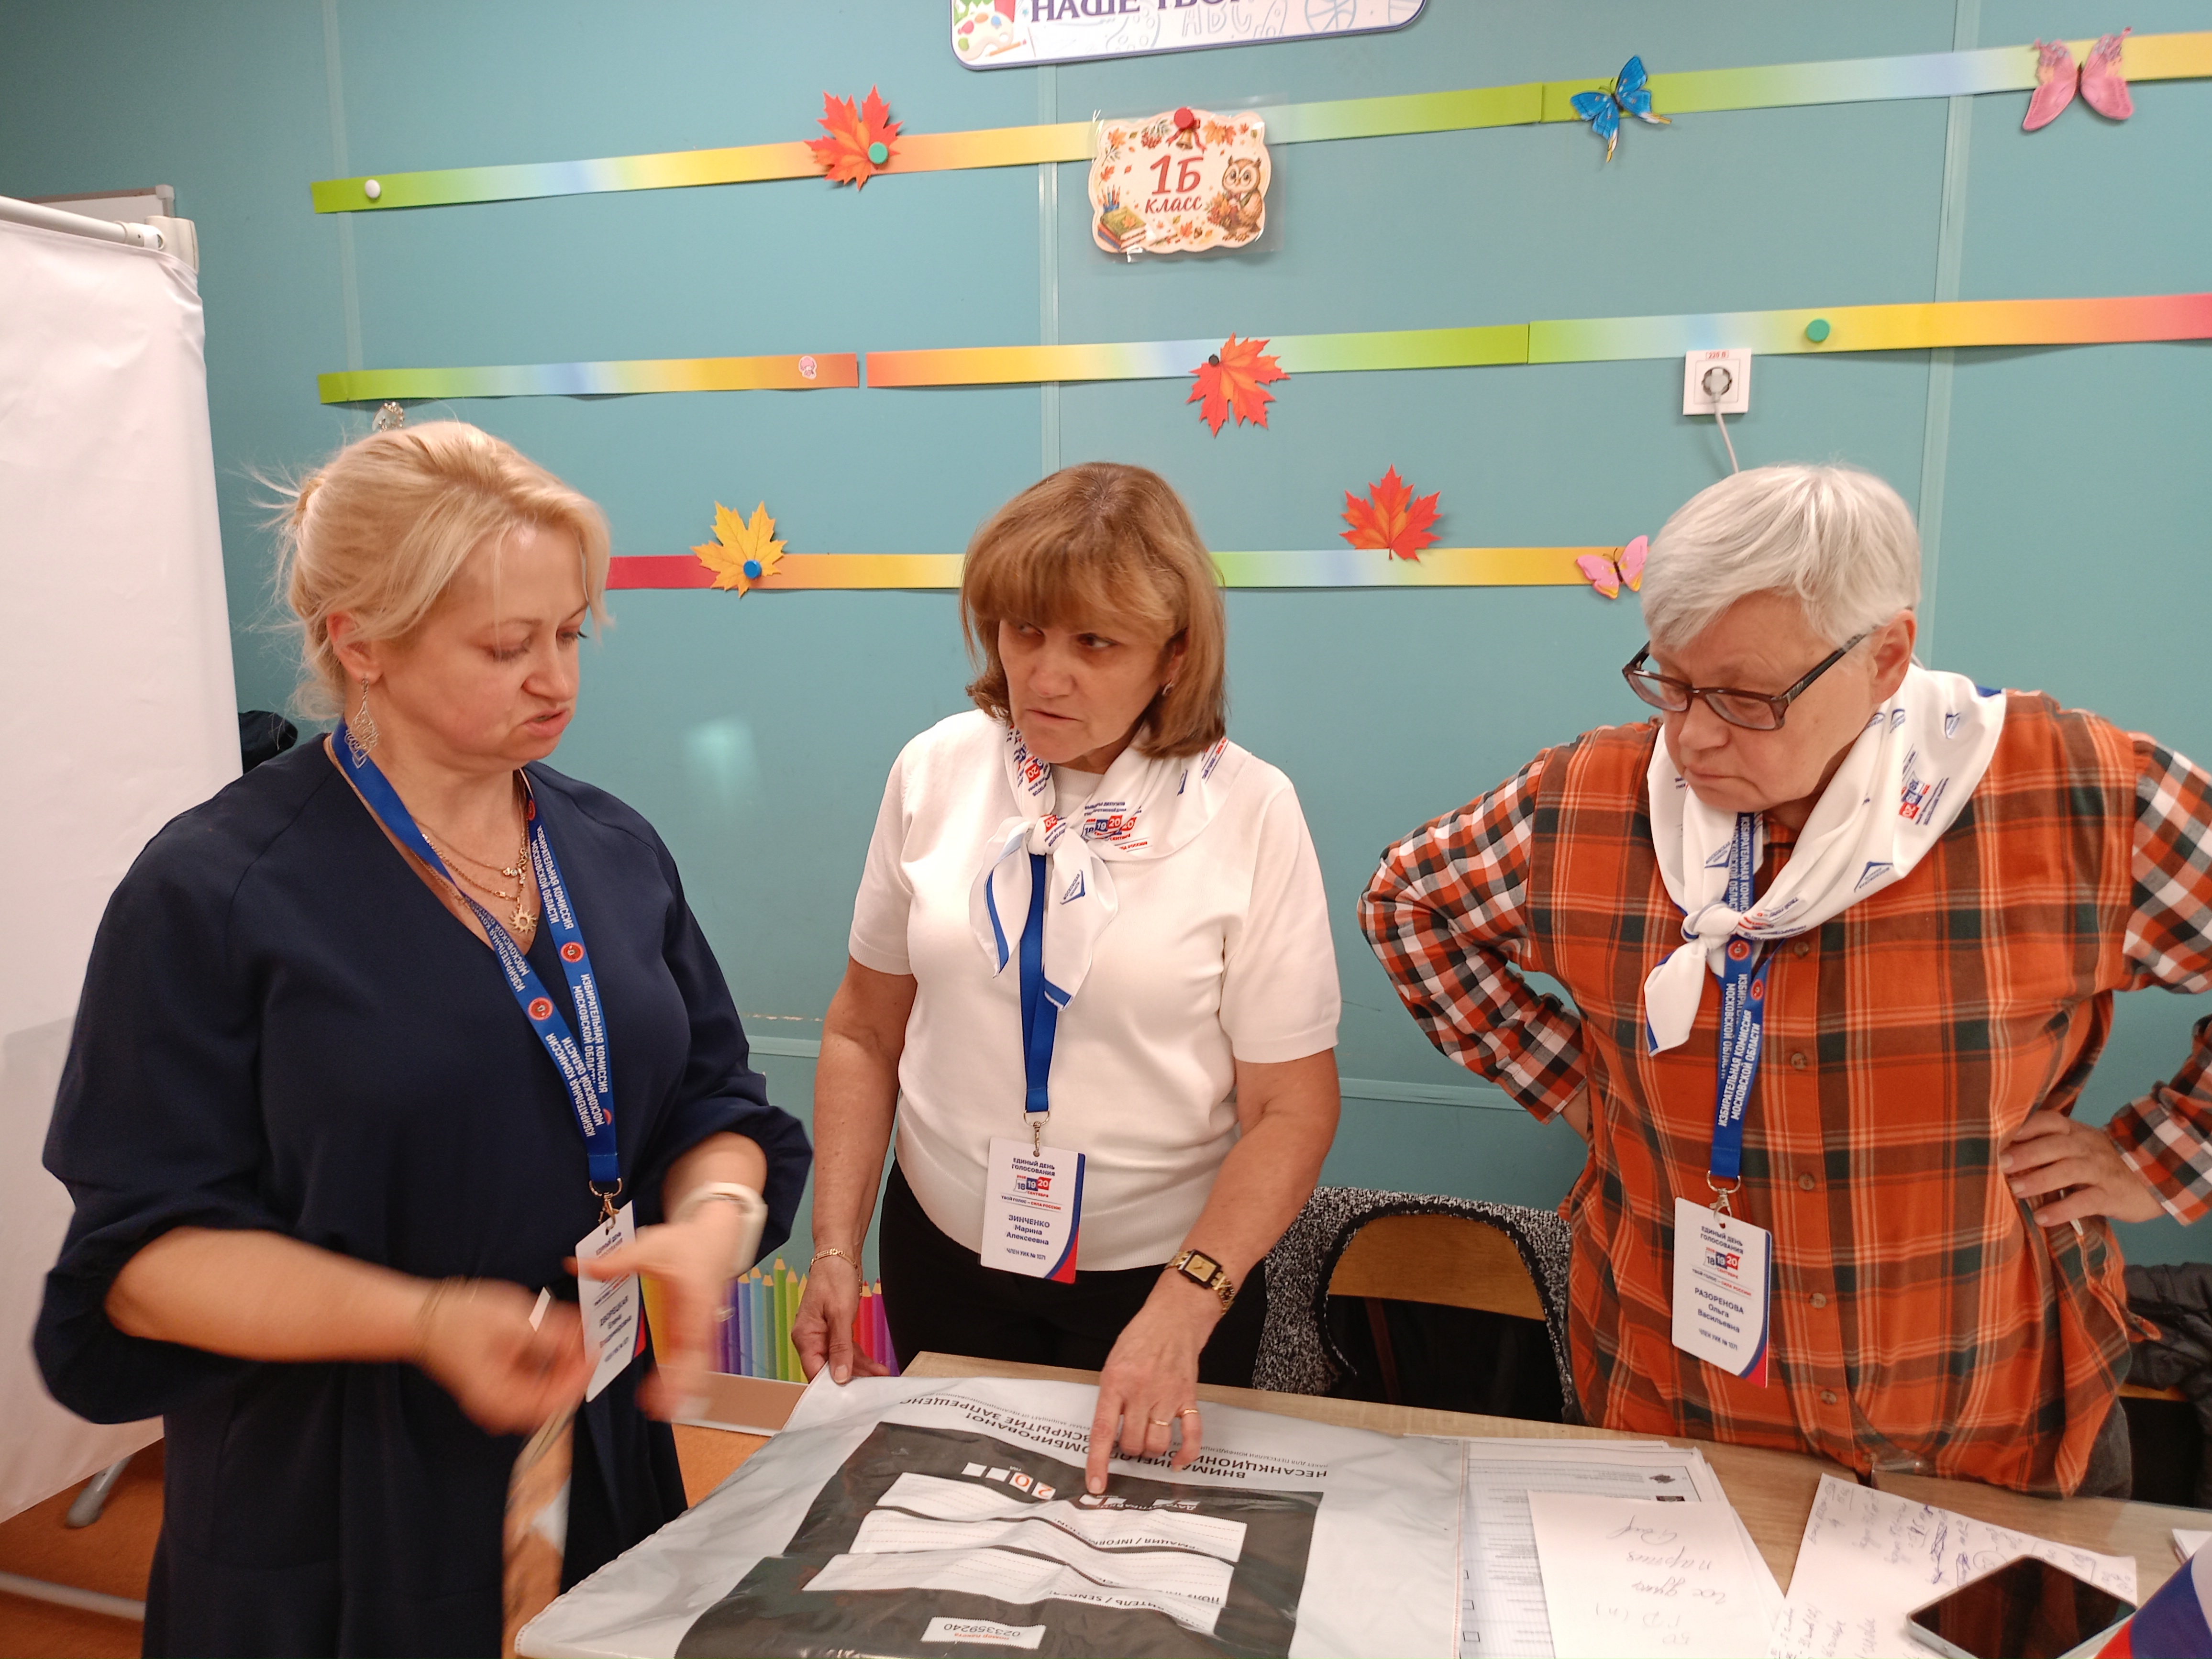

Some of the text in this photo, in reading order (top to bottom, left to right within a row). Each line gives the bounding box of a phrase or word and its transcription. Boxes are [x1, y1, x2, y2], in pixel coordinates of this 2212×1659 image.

[1150, 155, 1204, 196] 1Б
[1109, 818, 1120, 827] 20
[531, 840, 560, 924] МОСКОВСКОЙ ОБЛАСТИ
[537, 825, 574, 930] ИЗБИРАТЕЛЬНАЯ КОМИССИЯ
[490, 929, 525, 992] ИЗБИРАТЕЛЬНАЯ
[495, 924, 530, 976] МОСКОВСКОЙ
[573, 985, 594, 1044] МОСКОВСКОЙ
[1723, 983, 1736, 1040] МОСКОВСКОЙ
[581, 973, 608, 1093] ИЗБИРАТЕЛЬНАЯ КОМИССИЯ
[1718, 1009, 1751, 1127] ИЗБИРАТЕЛЬНАЯ КОМИССИЯ
[1730, 1022, 1760, 1120] МОСКОВСКОЙ ОБЛАСТИ
[545, 1033, 596, 1137] ИЗБИРАТЕЛЬНАЯ КОМИССИЯ
[561, 1037, 605, 1127] МОСКОВСКОЙ ОБЛАСТИ
[1012, 1164, 1055, 1176] ГОЛОСОВАНИЯ
[1013, 1157, 1039, 1167] ЕДИНЫЙ
[1017, 1179, 1049, 1190] 18 19 20
[1008, 1214, 1050, 1228] ЗИНЧЕНКО
[1015, 1225, 1042, 1236] Марина
[1006, 1231, 1049, 1245] Алексеевна
[1700, 1233, 1744, 1255] ГОЛОСОВАНИЯ
[1706, 1256, 1715, 1266] 18
[1726, 1256, 1737, 1267] 20
[1694, 1287, 1744, 1315] РАЗОРЕНОВА
[1708, 1304, 1729, 1318] Ольга
[1698, 1309, 1740, 1333] Васильевна
[1004, 1416, 1091, 1443] ВСКРЫТИЕ
[944, 1624, 1021, 1637] 023359240
